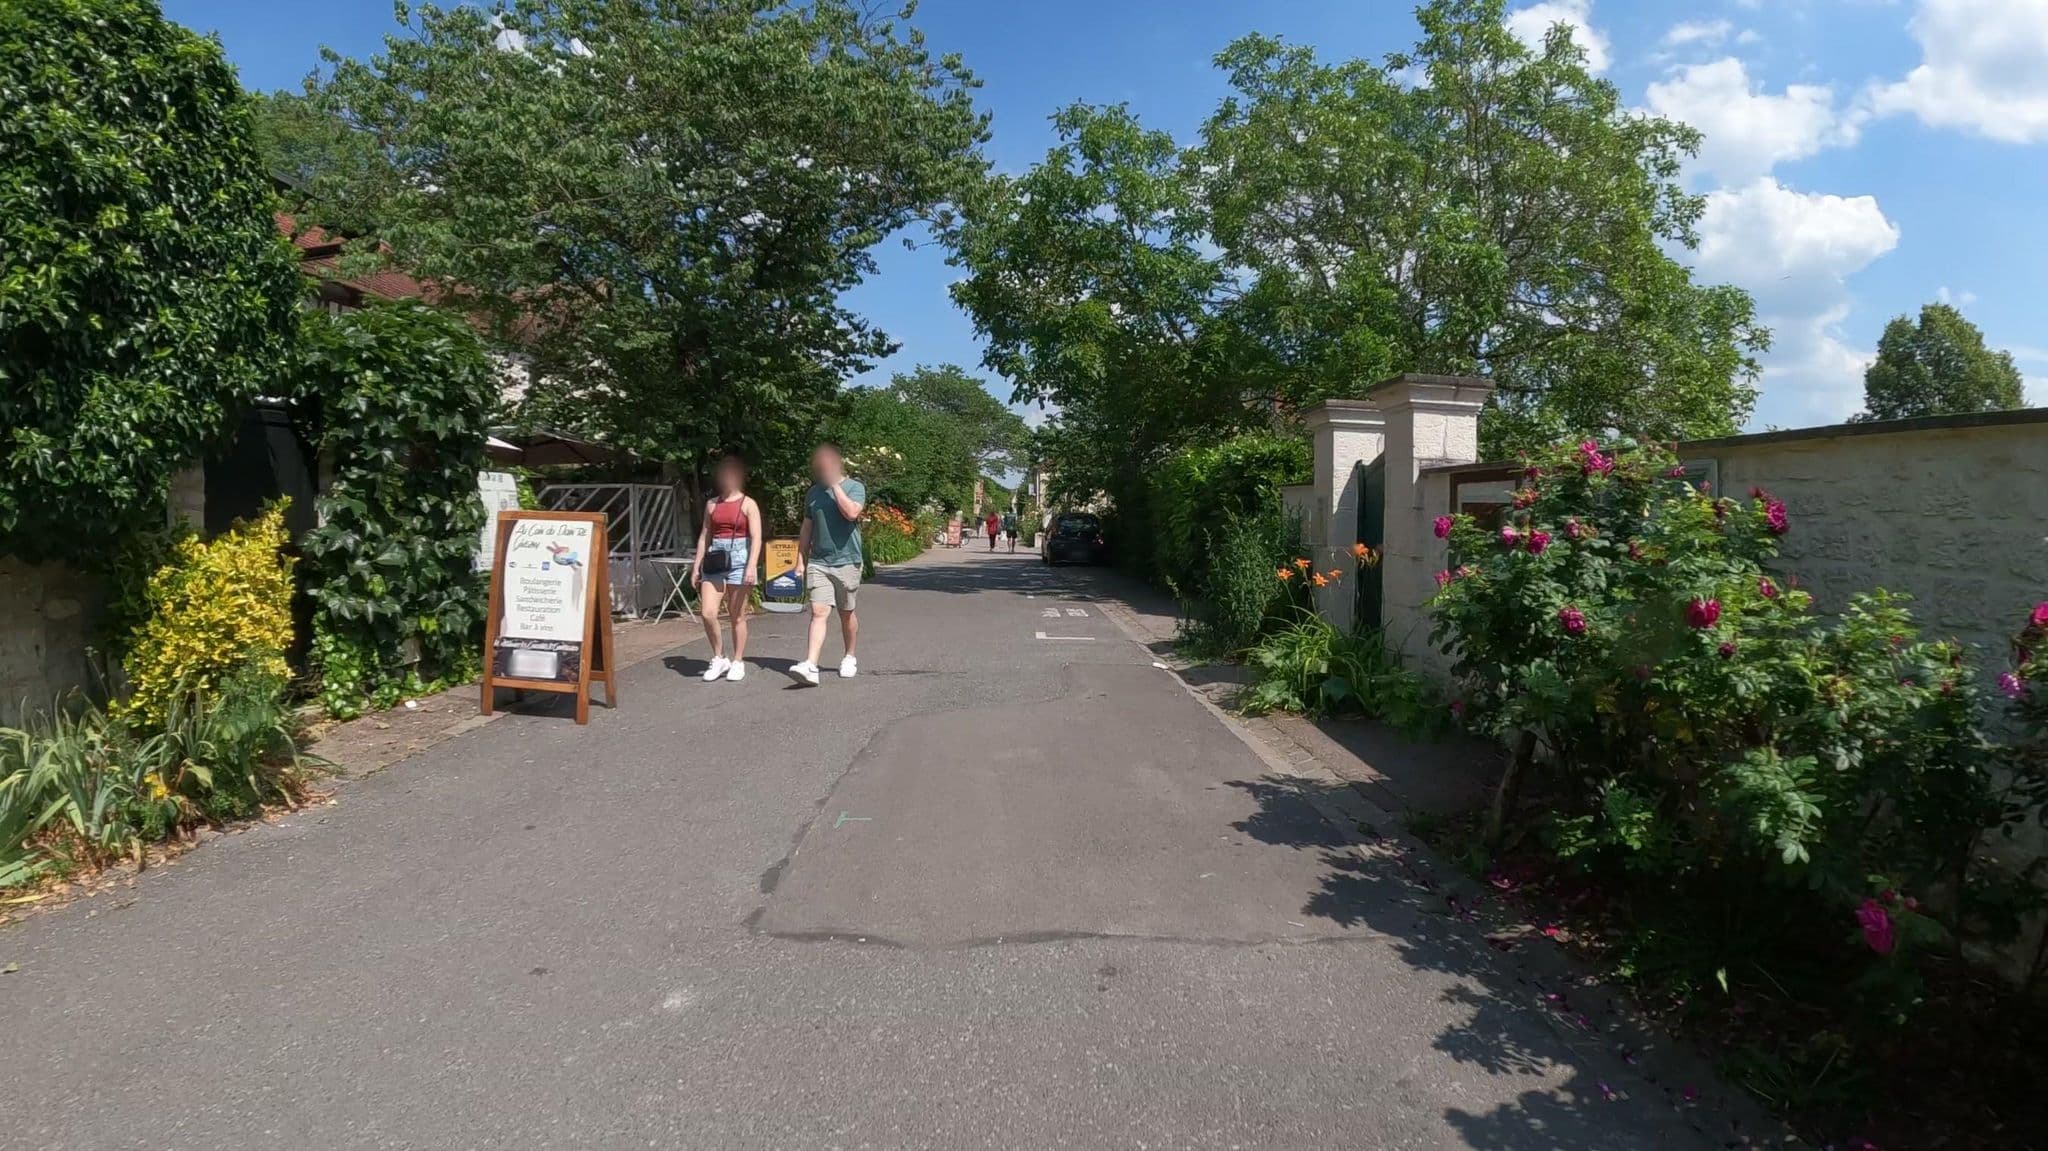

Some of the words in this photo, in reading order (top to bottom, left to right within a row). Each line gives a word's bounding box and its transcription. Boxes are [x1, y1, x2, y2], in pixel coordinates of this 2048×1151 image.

[520, 577, 562, 587] Boulangerie
[516, 595, 563, 604] Sandwicherie
[517, 604, 561, 613] Restauration
[520, 623, 532, 631] Bar
